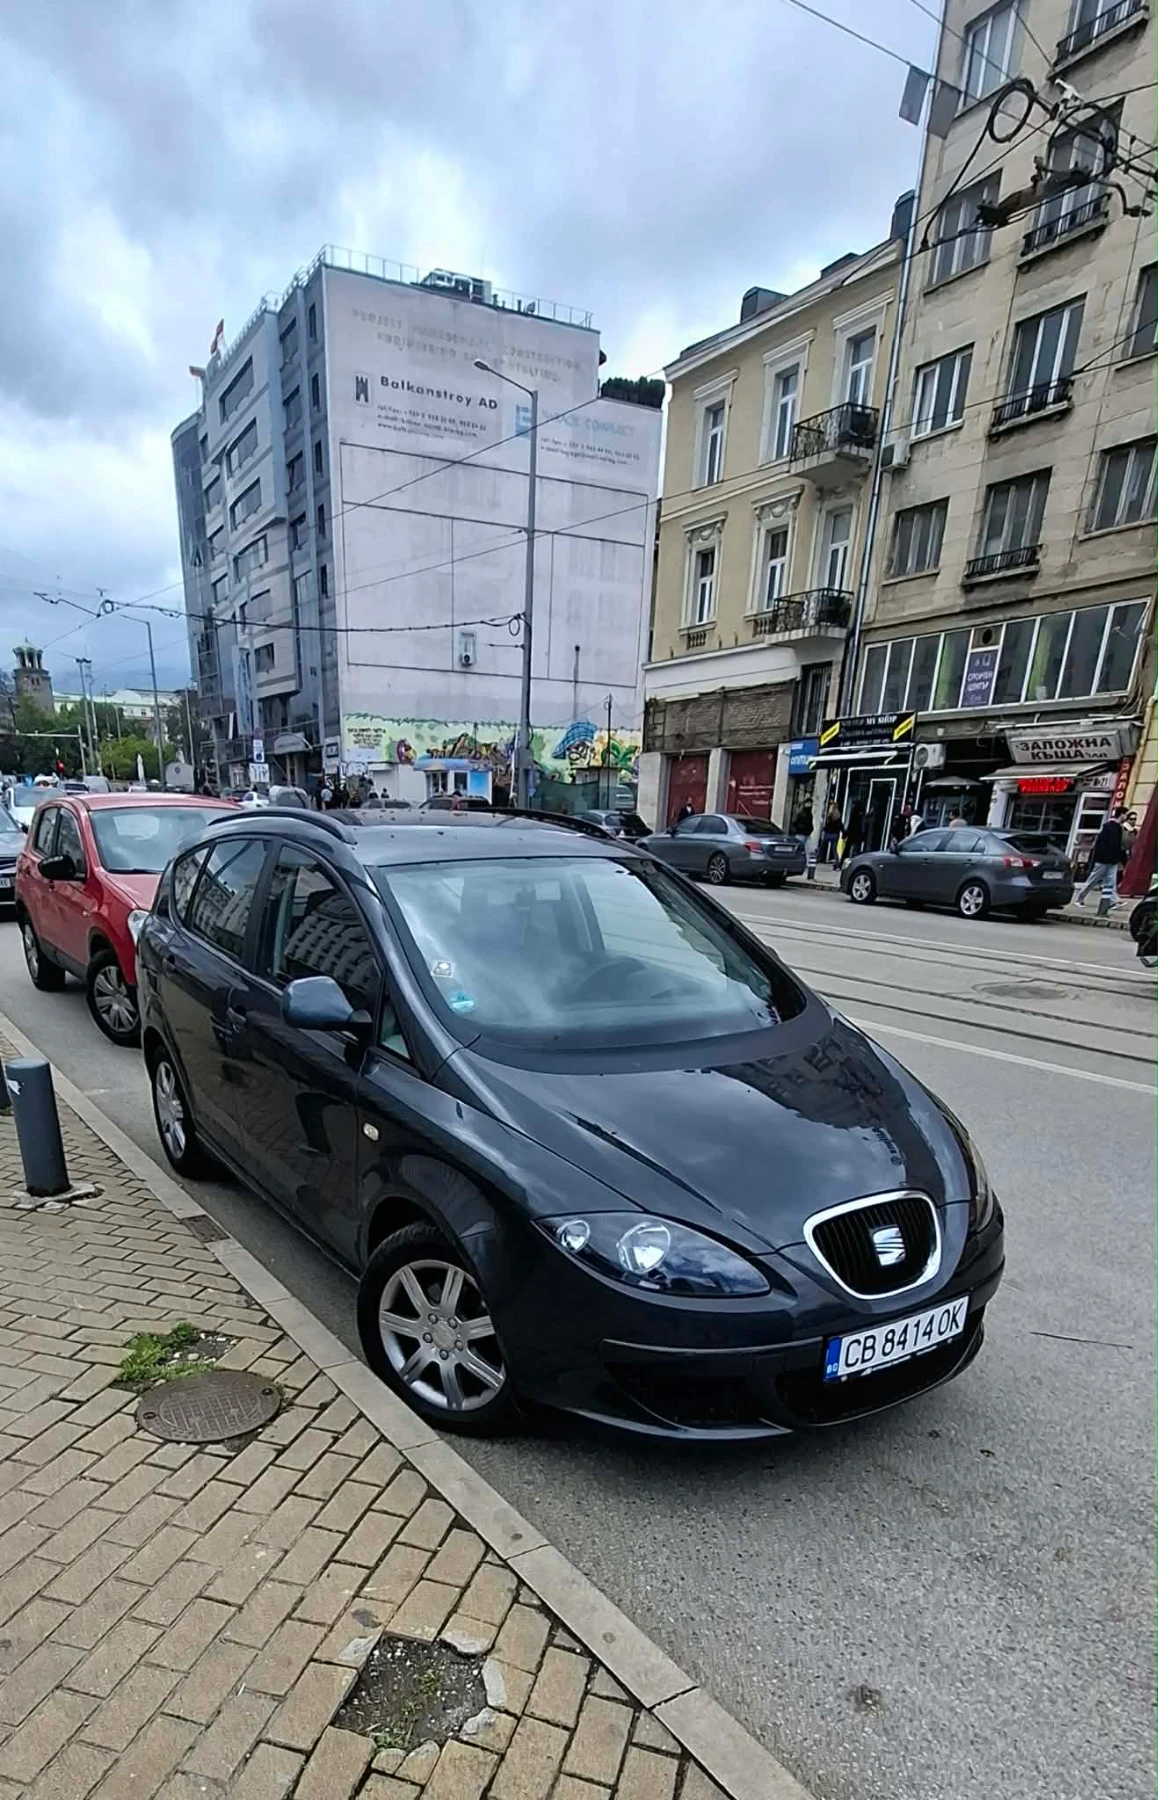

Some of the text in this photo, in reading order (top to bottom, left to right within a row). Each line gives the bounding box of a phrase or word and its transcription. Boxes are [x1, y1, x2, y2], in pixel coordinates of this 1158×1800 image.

[380, 375, 498, 410] Balkanstroy AD
[1019, 737, 1112, 752] ЗАЛОЖНА
[1031, 750, 1085, 760] КЪЩА
[881, 1313, 936, 1357] 8414
